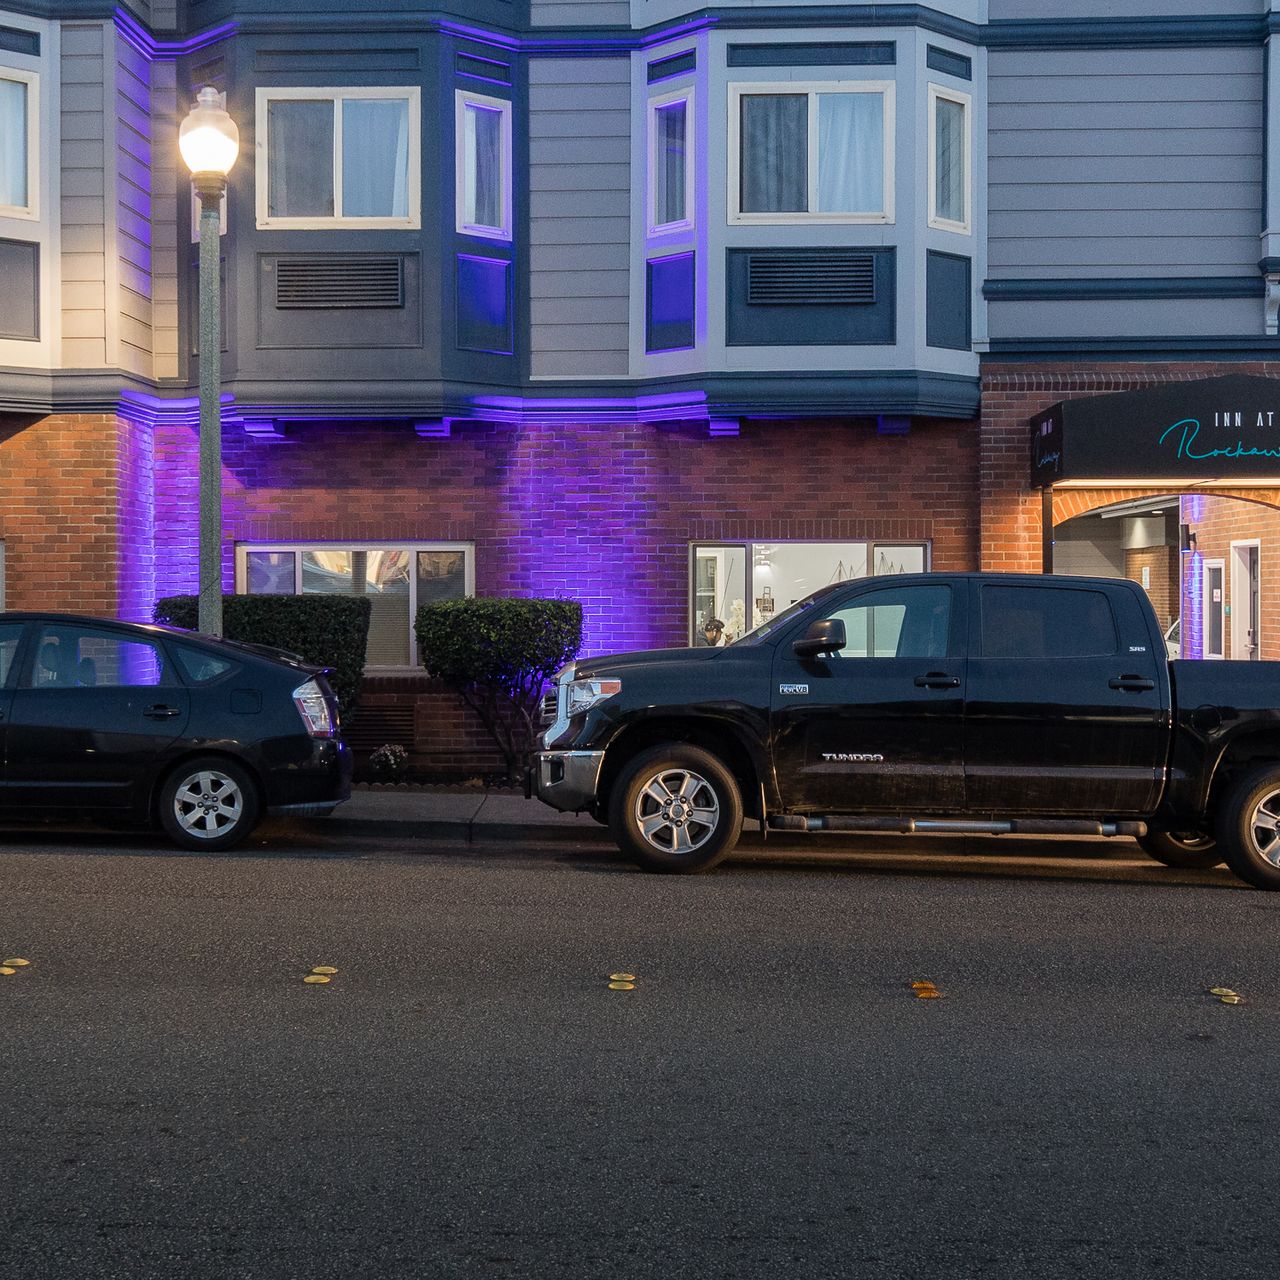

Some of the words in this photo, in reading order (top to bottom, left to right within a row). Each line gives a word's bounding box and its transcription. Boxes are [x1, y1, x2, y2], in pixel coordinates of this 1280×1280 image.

[1215, 412, 1241, 427] INN
[1256, 411, 1274, 427] AT
[822, 753, 884, 761] TUNDRA
